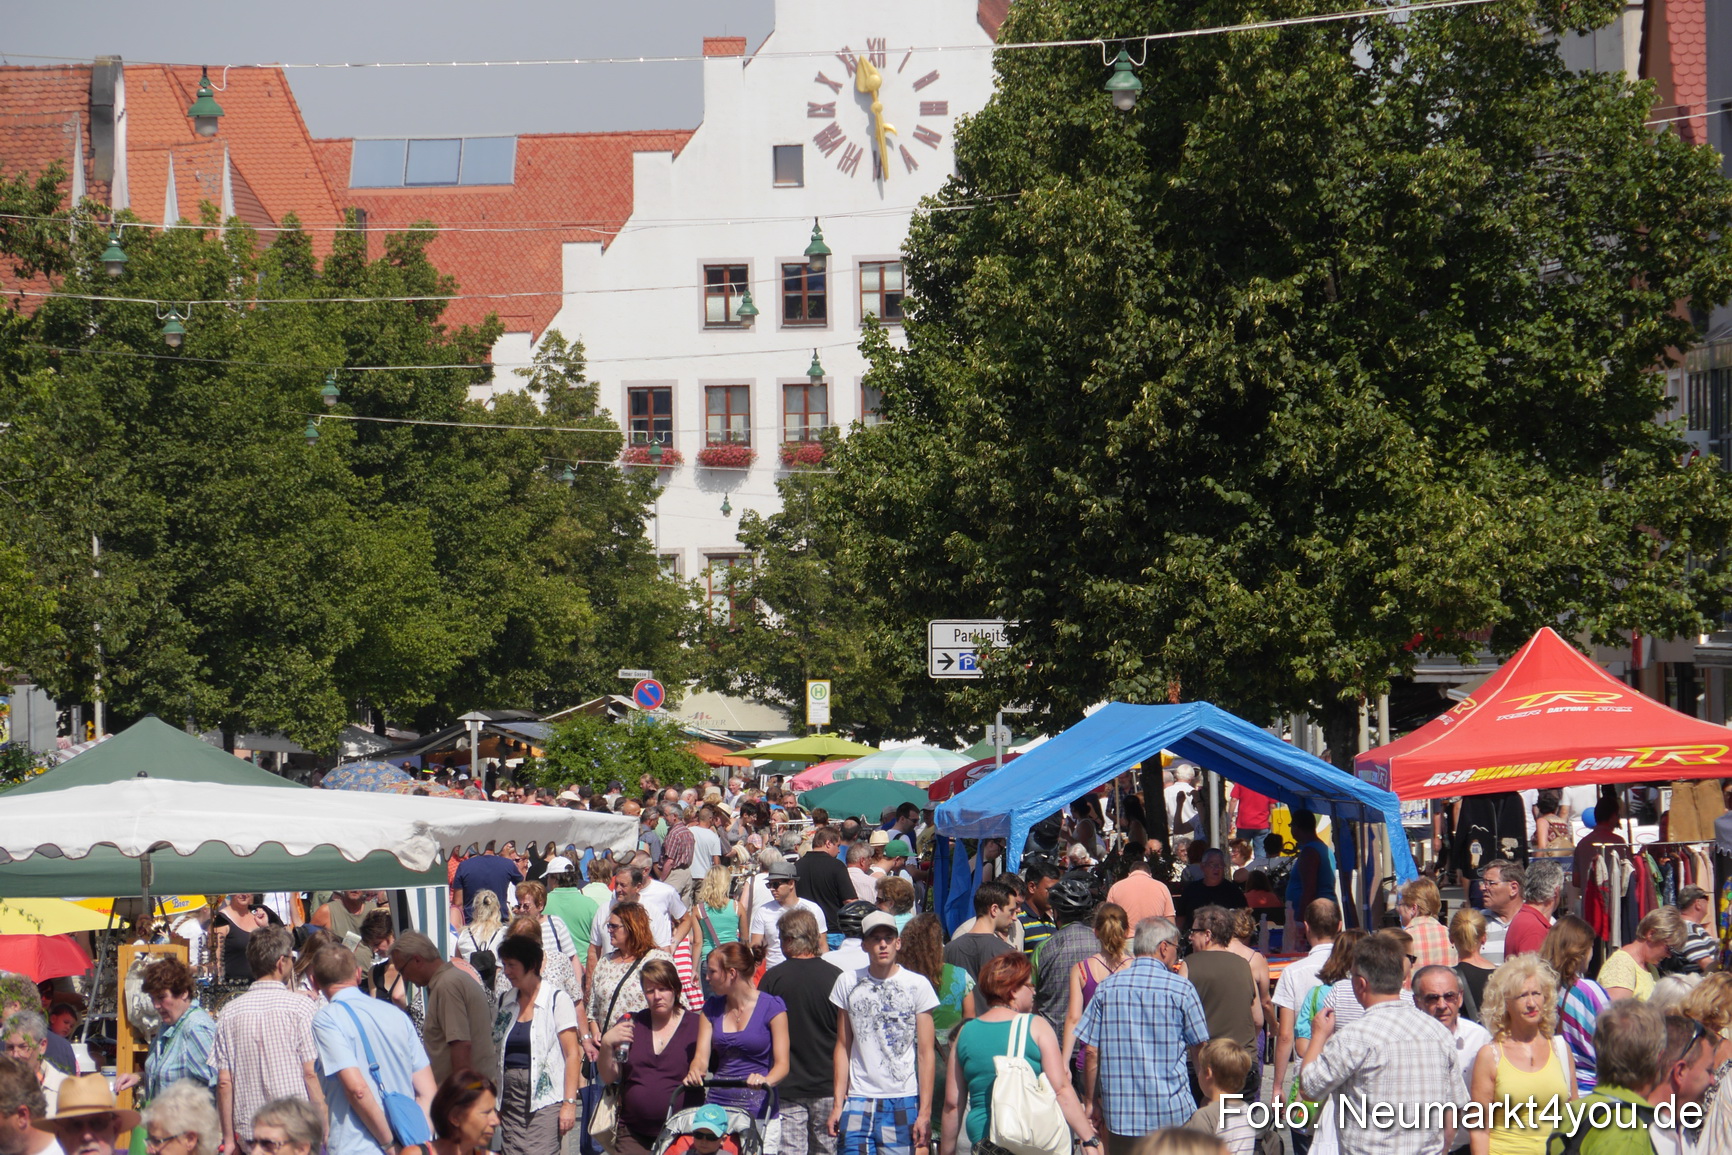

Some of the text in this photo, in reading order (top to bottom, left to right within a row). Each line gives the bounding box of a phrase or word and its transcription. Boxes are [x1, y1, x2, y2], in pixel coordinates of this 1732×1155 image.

[954, 628, 1008, 642] Parkleits
[1423, 755, 1634, 787] RSRMINIBIKE.COM
[172, 898, 190, 908] Bier
